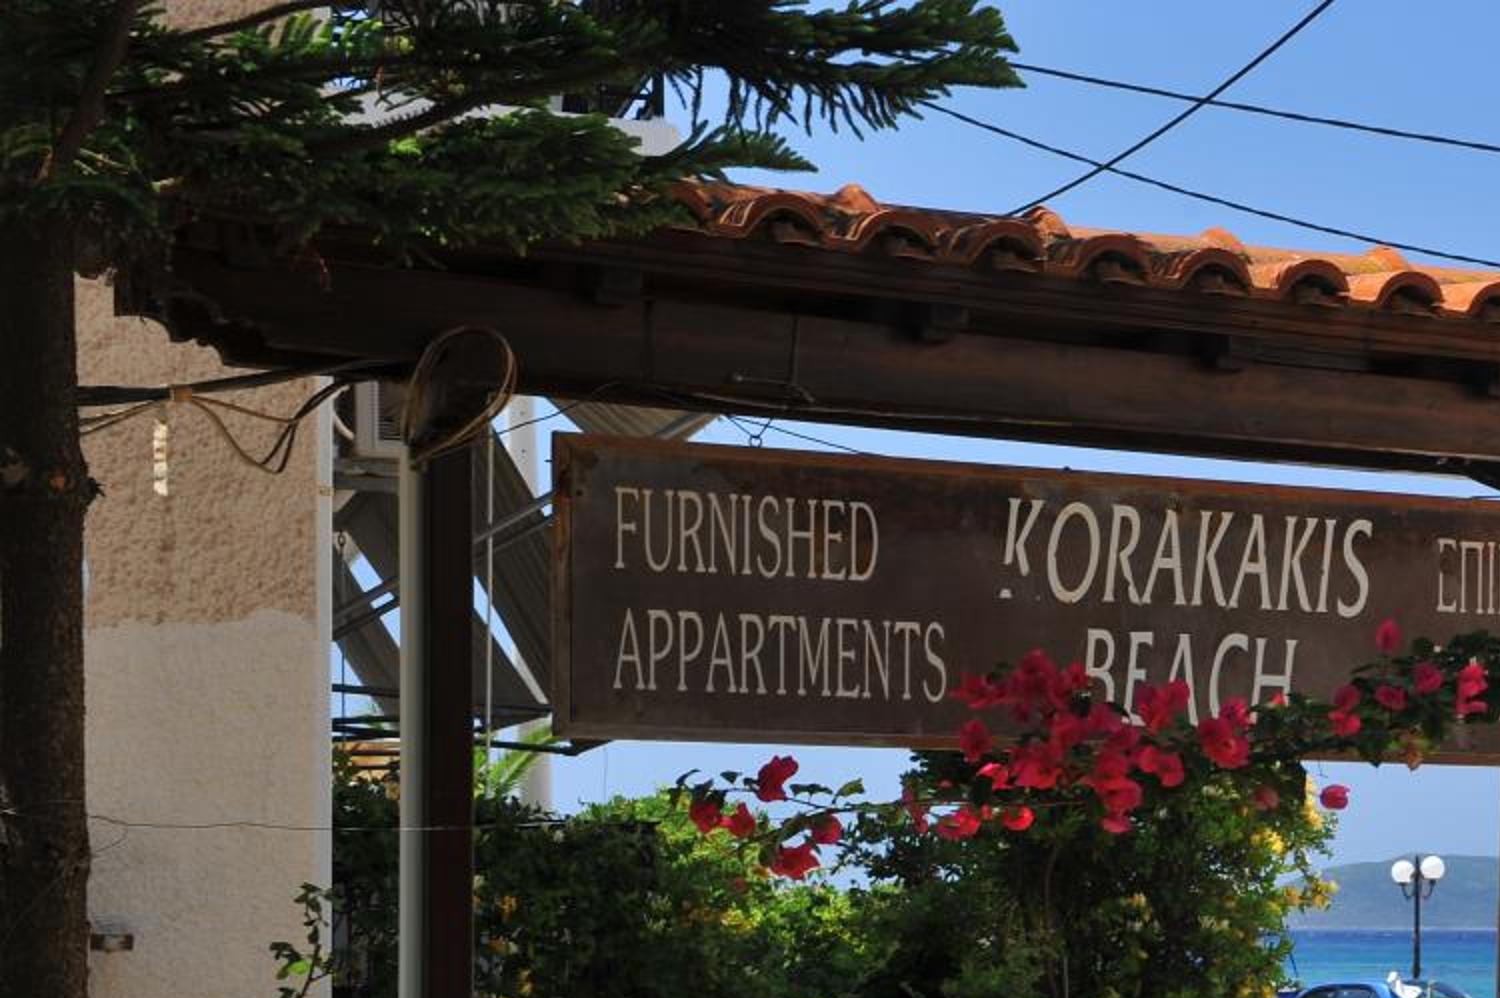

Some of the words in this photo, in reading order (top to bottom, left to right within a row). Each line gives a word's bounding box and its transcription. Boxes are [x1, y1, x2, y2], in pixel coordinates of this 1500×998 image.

[614, 487, 879, 581] FURNISHED
[999, 497, 1373, 618] KORAKAKIS
[613, 607, 947, 702] APPARTMENTS
[1085, 628, 1299, 728] BEACH
